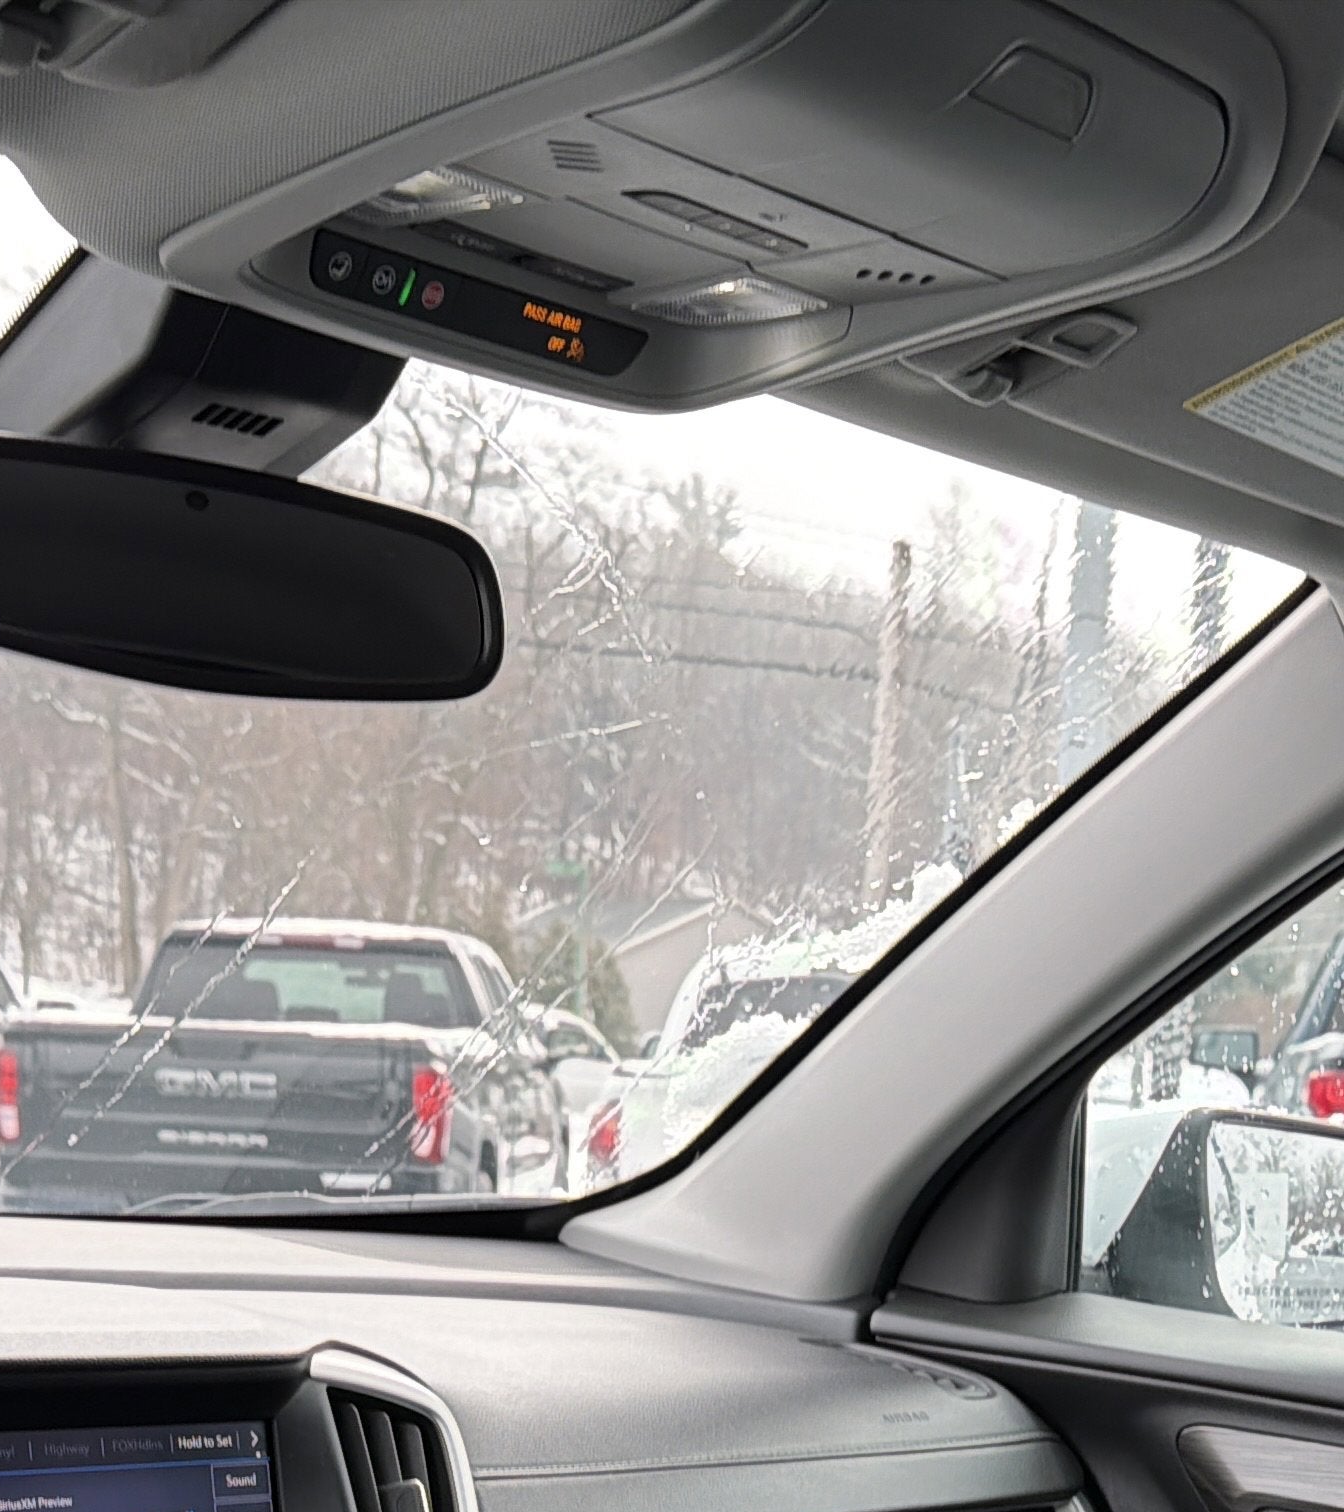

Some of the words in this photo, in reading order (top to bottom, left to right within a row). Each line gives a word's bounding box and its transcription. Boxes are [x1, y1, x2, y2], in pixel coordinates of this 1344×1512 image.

[523, 302, 548, 322] PASS
[547, 335, 566, 353] OFF
[155, 1067, 277, 1099] GMC
[178, 1436, 202, 1449] Hold
[204, 1436, 214, 1448] to
[216, 1434, 233, 1448] Set
[226, 1472, 257, 1487] Sound
[38, 1496, 73, 1510] Preview
